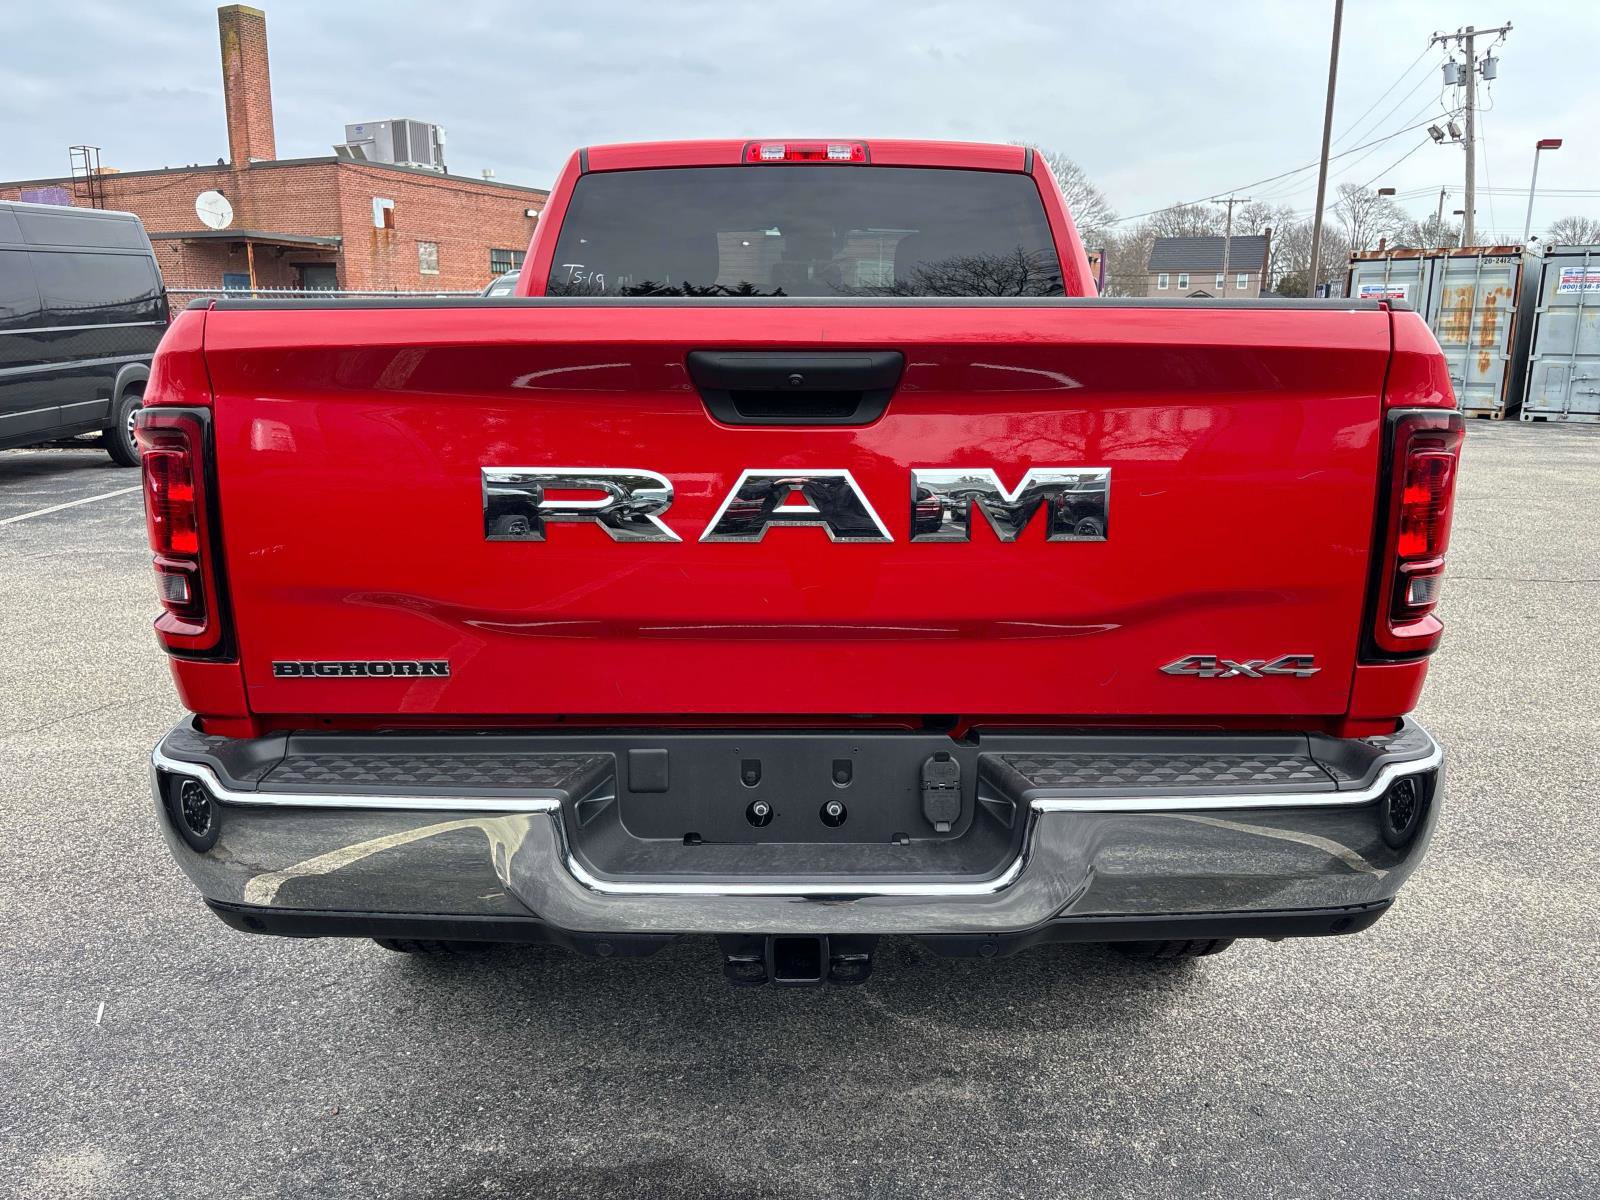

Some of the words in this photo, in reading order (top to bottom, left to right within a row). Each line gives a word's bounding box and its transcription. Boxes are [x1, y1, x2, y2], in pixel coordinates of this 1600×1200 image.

[481, 466, 1111, 543] RAM
[272, 660, 450, 677] BIGHORN
[1158, 654, 1322, 678] 4x4
